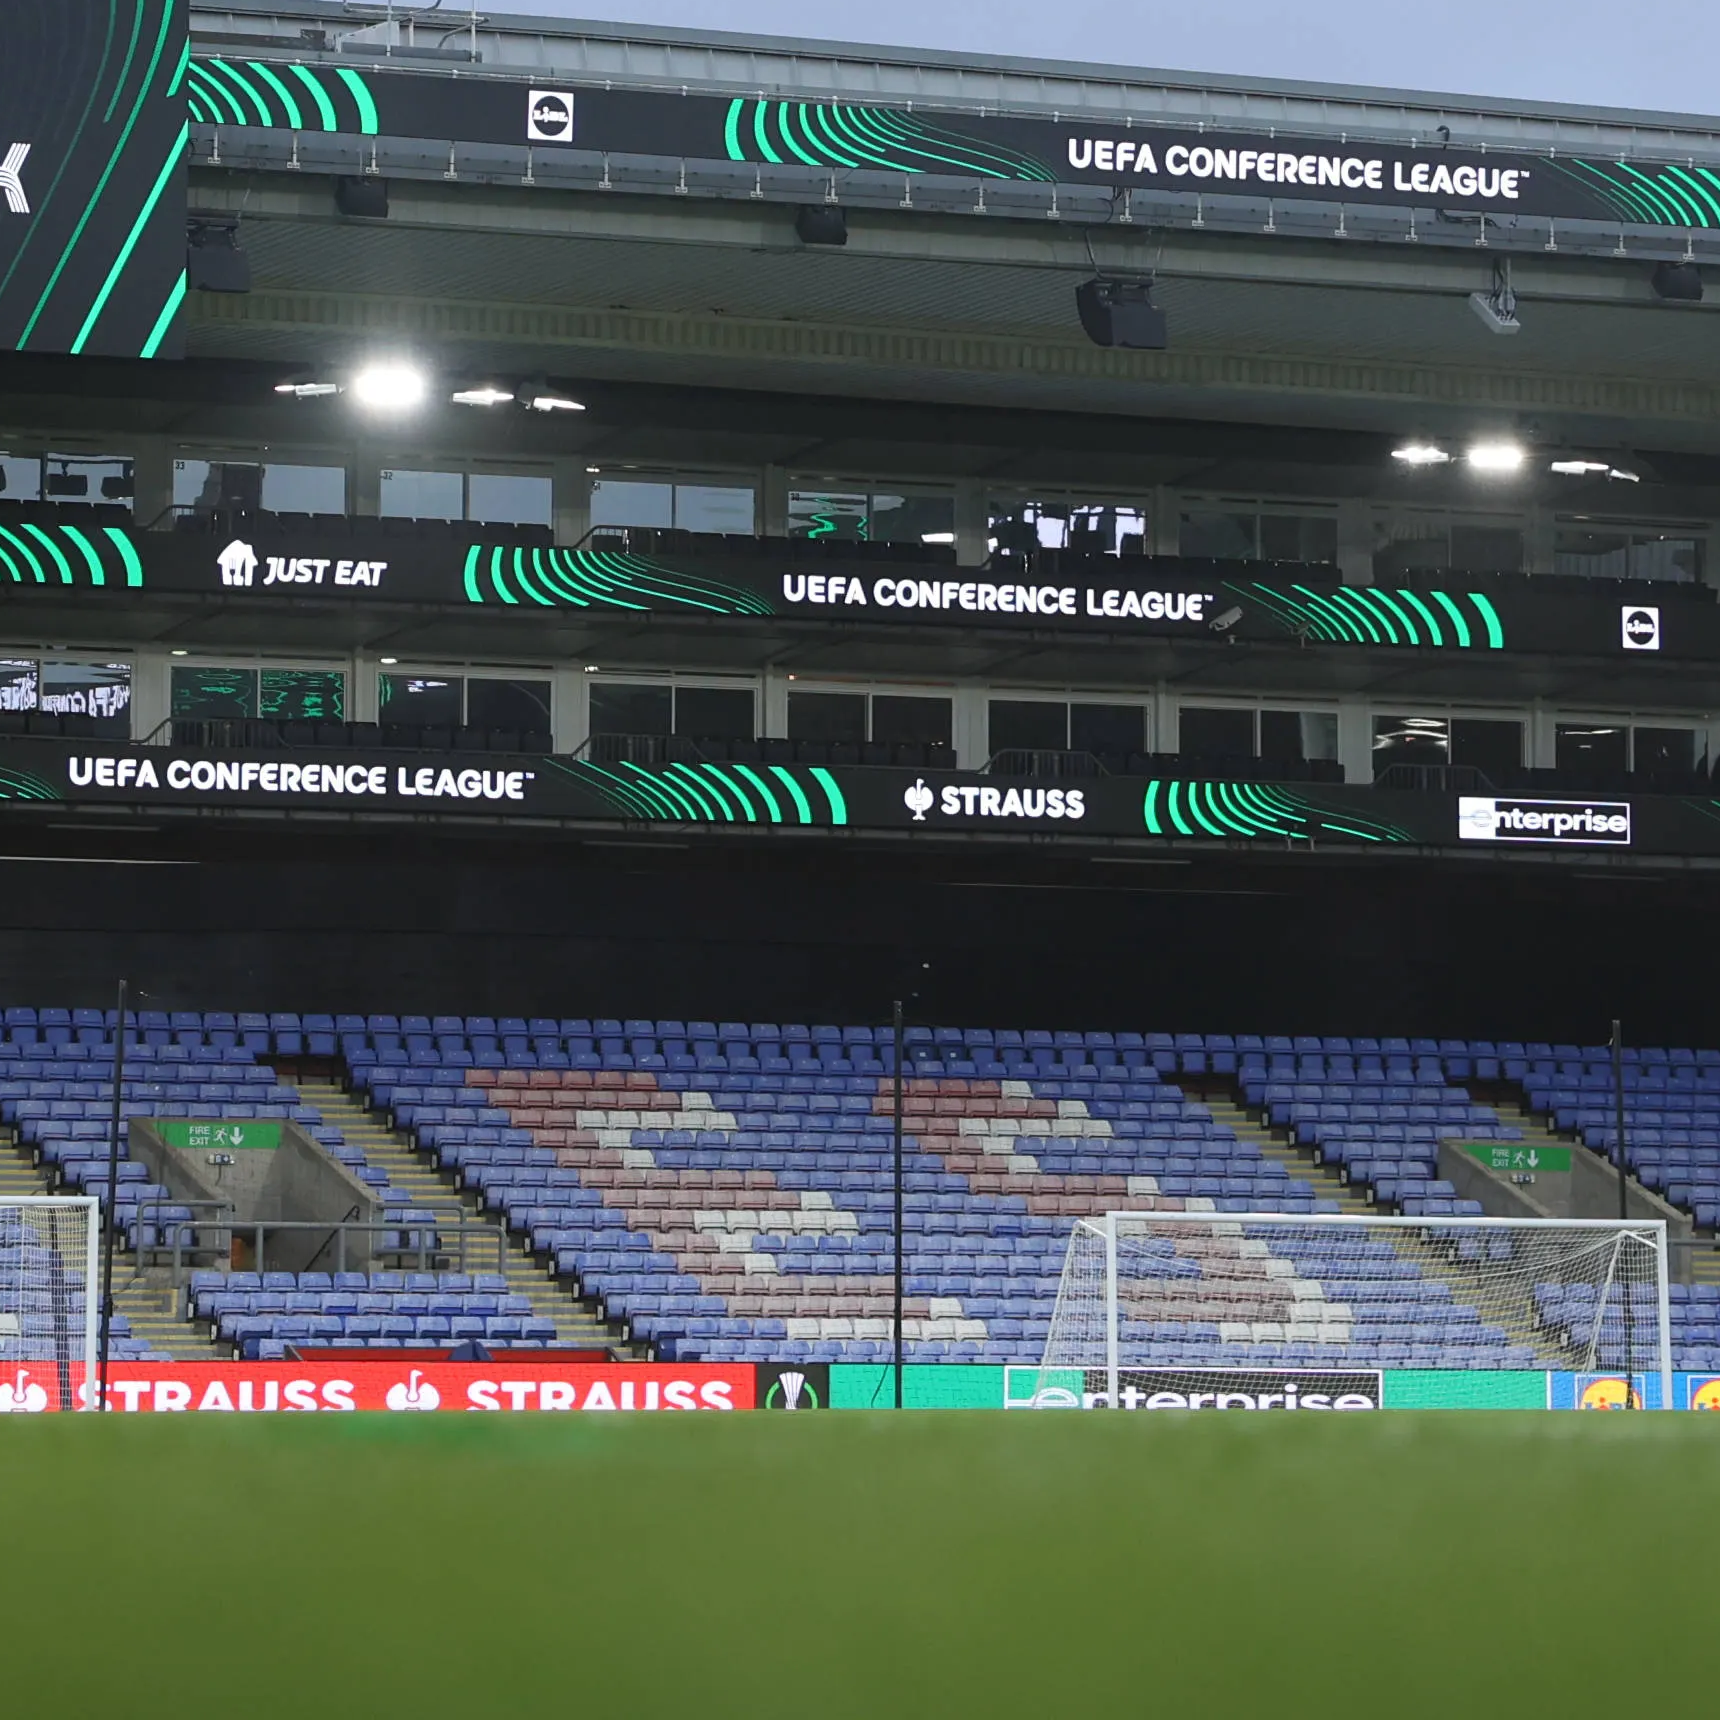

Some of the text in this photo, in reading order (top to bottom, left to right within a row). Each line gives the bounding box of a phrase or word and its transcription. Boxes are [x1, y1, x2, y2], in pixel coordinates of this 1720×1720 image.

[1067, 138, 1158, 175] UEFA
[1165, 145, 1383, 191] CONFERENCE
[175, 461, 185, 470] 33
[263, 556, 388, 588] JUST EAT
[783, 574, 867, 605] UEFA
[873, 575, 1077, 615] CONFERENCE
[69, 756, 160, 788] UEFA
[166, 759, 387, 795] CONFERENCE
[940, 785, 1085, 819] STRAUSS
[1471, 808, 1628, 837] enterprise
[189, 1126, 211, 1135] FIRE
[189, 1136, 209, 1145] EXIT
[1491, 1148, 1510, 1158] FIRE
[1492, 1158, 1509, 1167] EXIT
[466, 1380, 734, 1411] STRAUSS
